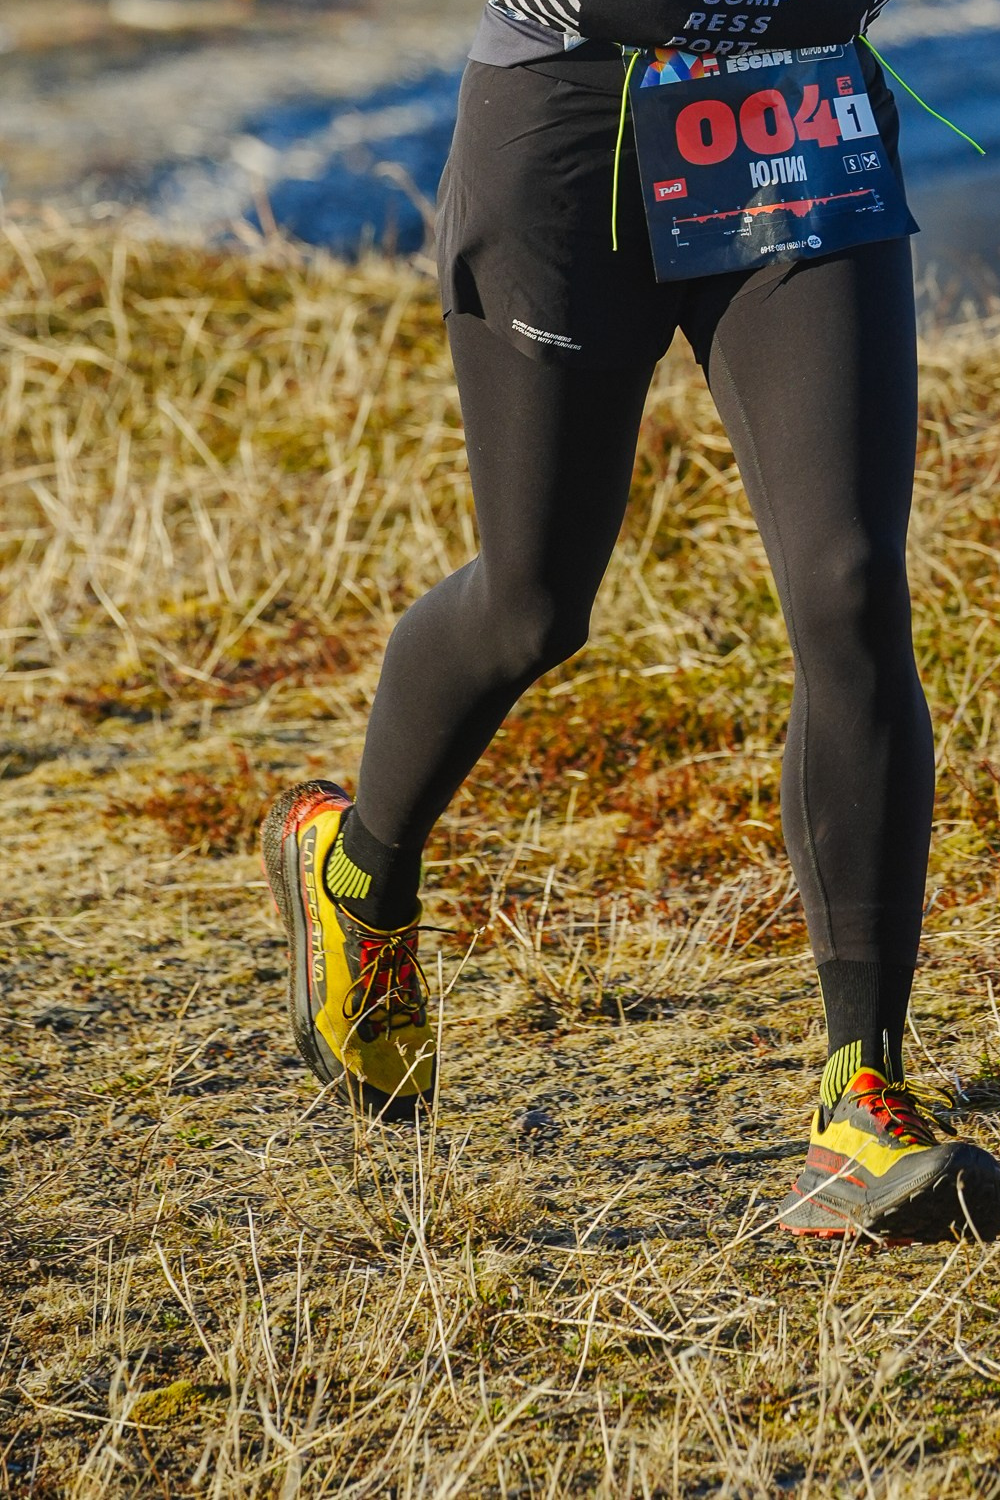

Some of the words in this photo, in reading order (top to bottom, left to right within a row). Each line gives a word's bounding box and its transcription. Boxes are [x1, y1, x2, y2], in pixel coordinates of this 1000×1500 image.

[683, 12, 771, 35] RESS
[726, 50, 793, 74] ESCAPE
[749, 155, 808, 188] ЮЛИЯ
[511, 324, 537, 339] EVOLVING
[537, 336, 554, 344] WITH
[553, 341, 582, 350] RUNNERS
[527, 326, 544, 335] FROM
[543, 332, 572, 342] RUNNERS
[304, 838, 314, 866] LA
[305, 871, 324, 982] SPORTIVA
